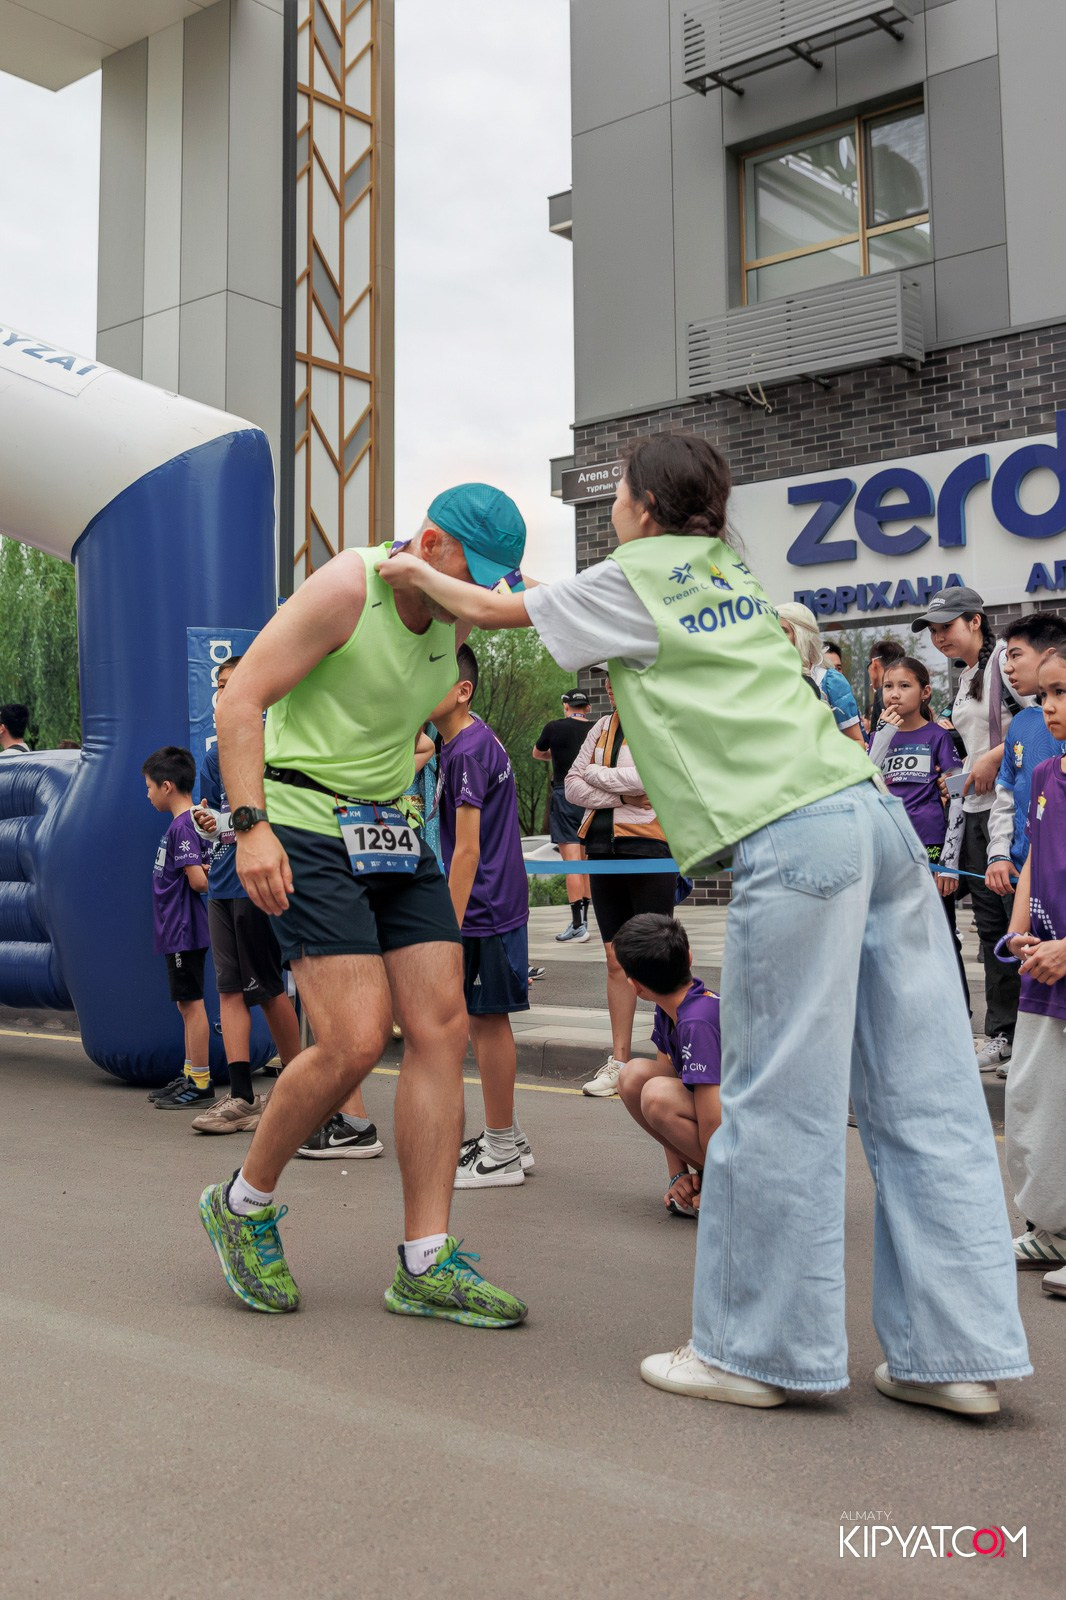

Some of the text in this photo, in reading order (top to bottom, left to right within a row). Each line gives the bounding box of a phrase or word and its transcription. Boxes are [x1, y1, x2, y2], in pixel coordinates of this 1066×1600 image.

[0, 328, 98, 375] YZAI
[578, 466, 622, 483] Arena Ci
[354, 827, 413, 852] 1294
[690, 1063, 706, 1072] City
